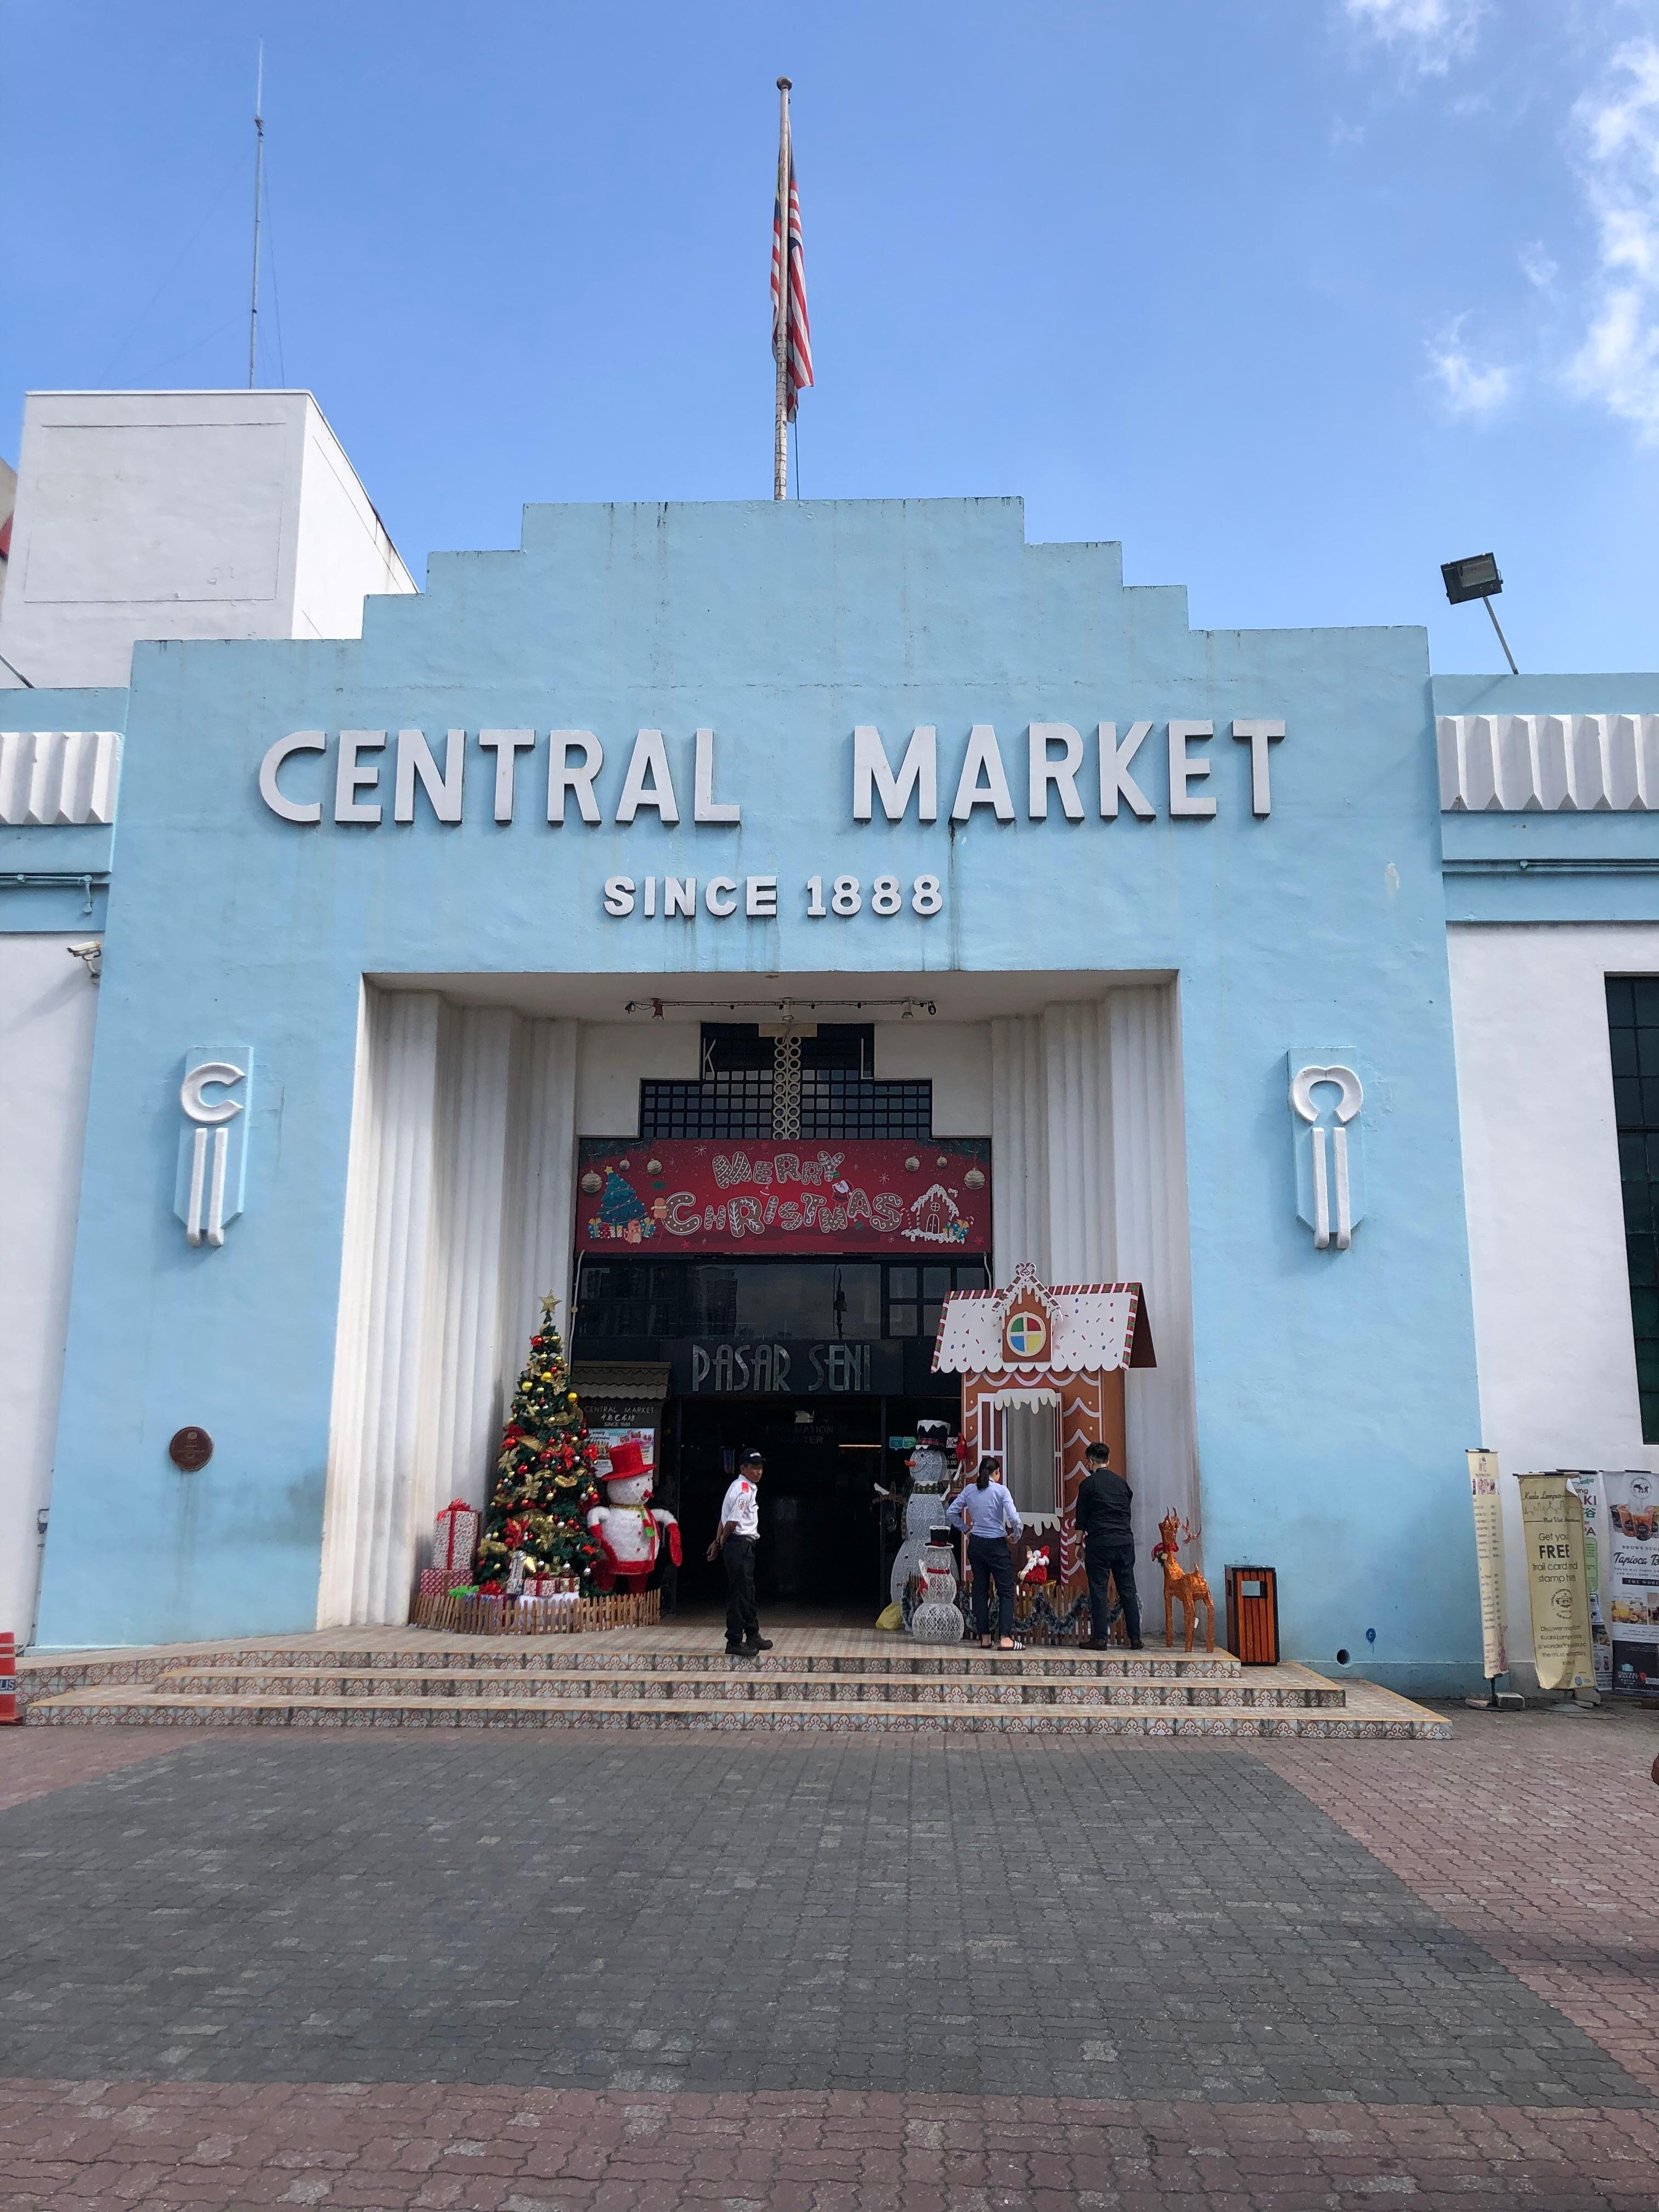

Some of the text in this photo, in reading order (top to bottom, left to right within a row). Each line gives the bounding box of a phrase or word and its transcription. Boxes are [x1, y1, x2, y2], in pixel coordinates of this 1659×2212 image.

[259, 719, 1286, 825] CENTRAL MARKET
[603, 875, 943, 917] SINCE 1888
[712, 1150, 845, 1189] MERRY
[664, 1188, 903, 1237] CHRISTMAS
[692, 1343, 870, 1391] PASAR SENI
[1584, 1496, 1597, 1505] KI
[1538, 1533, 1554, 1541] Get
[1539, 1544, 1570, 1559] FREE
[1613, 1552, 1648, 1566] Tapioca
[1533, 1562, 1546, 1571] trail
[1547, 1562, 1567, 1571] card
[1538, 1574, 1565, 1583] stamp
[0, 1679, 15, 1690] LIS
